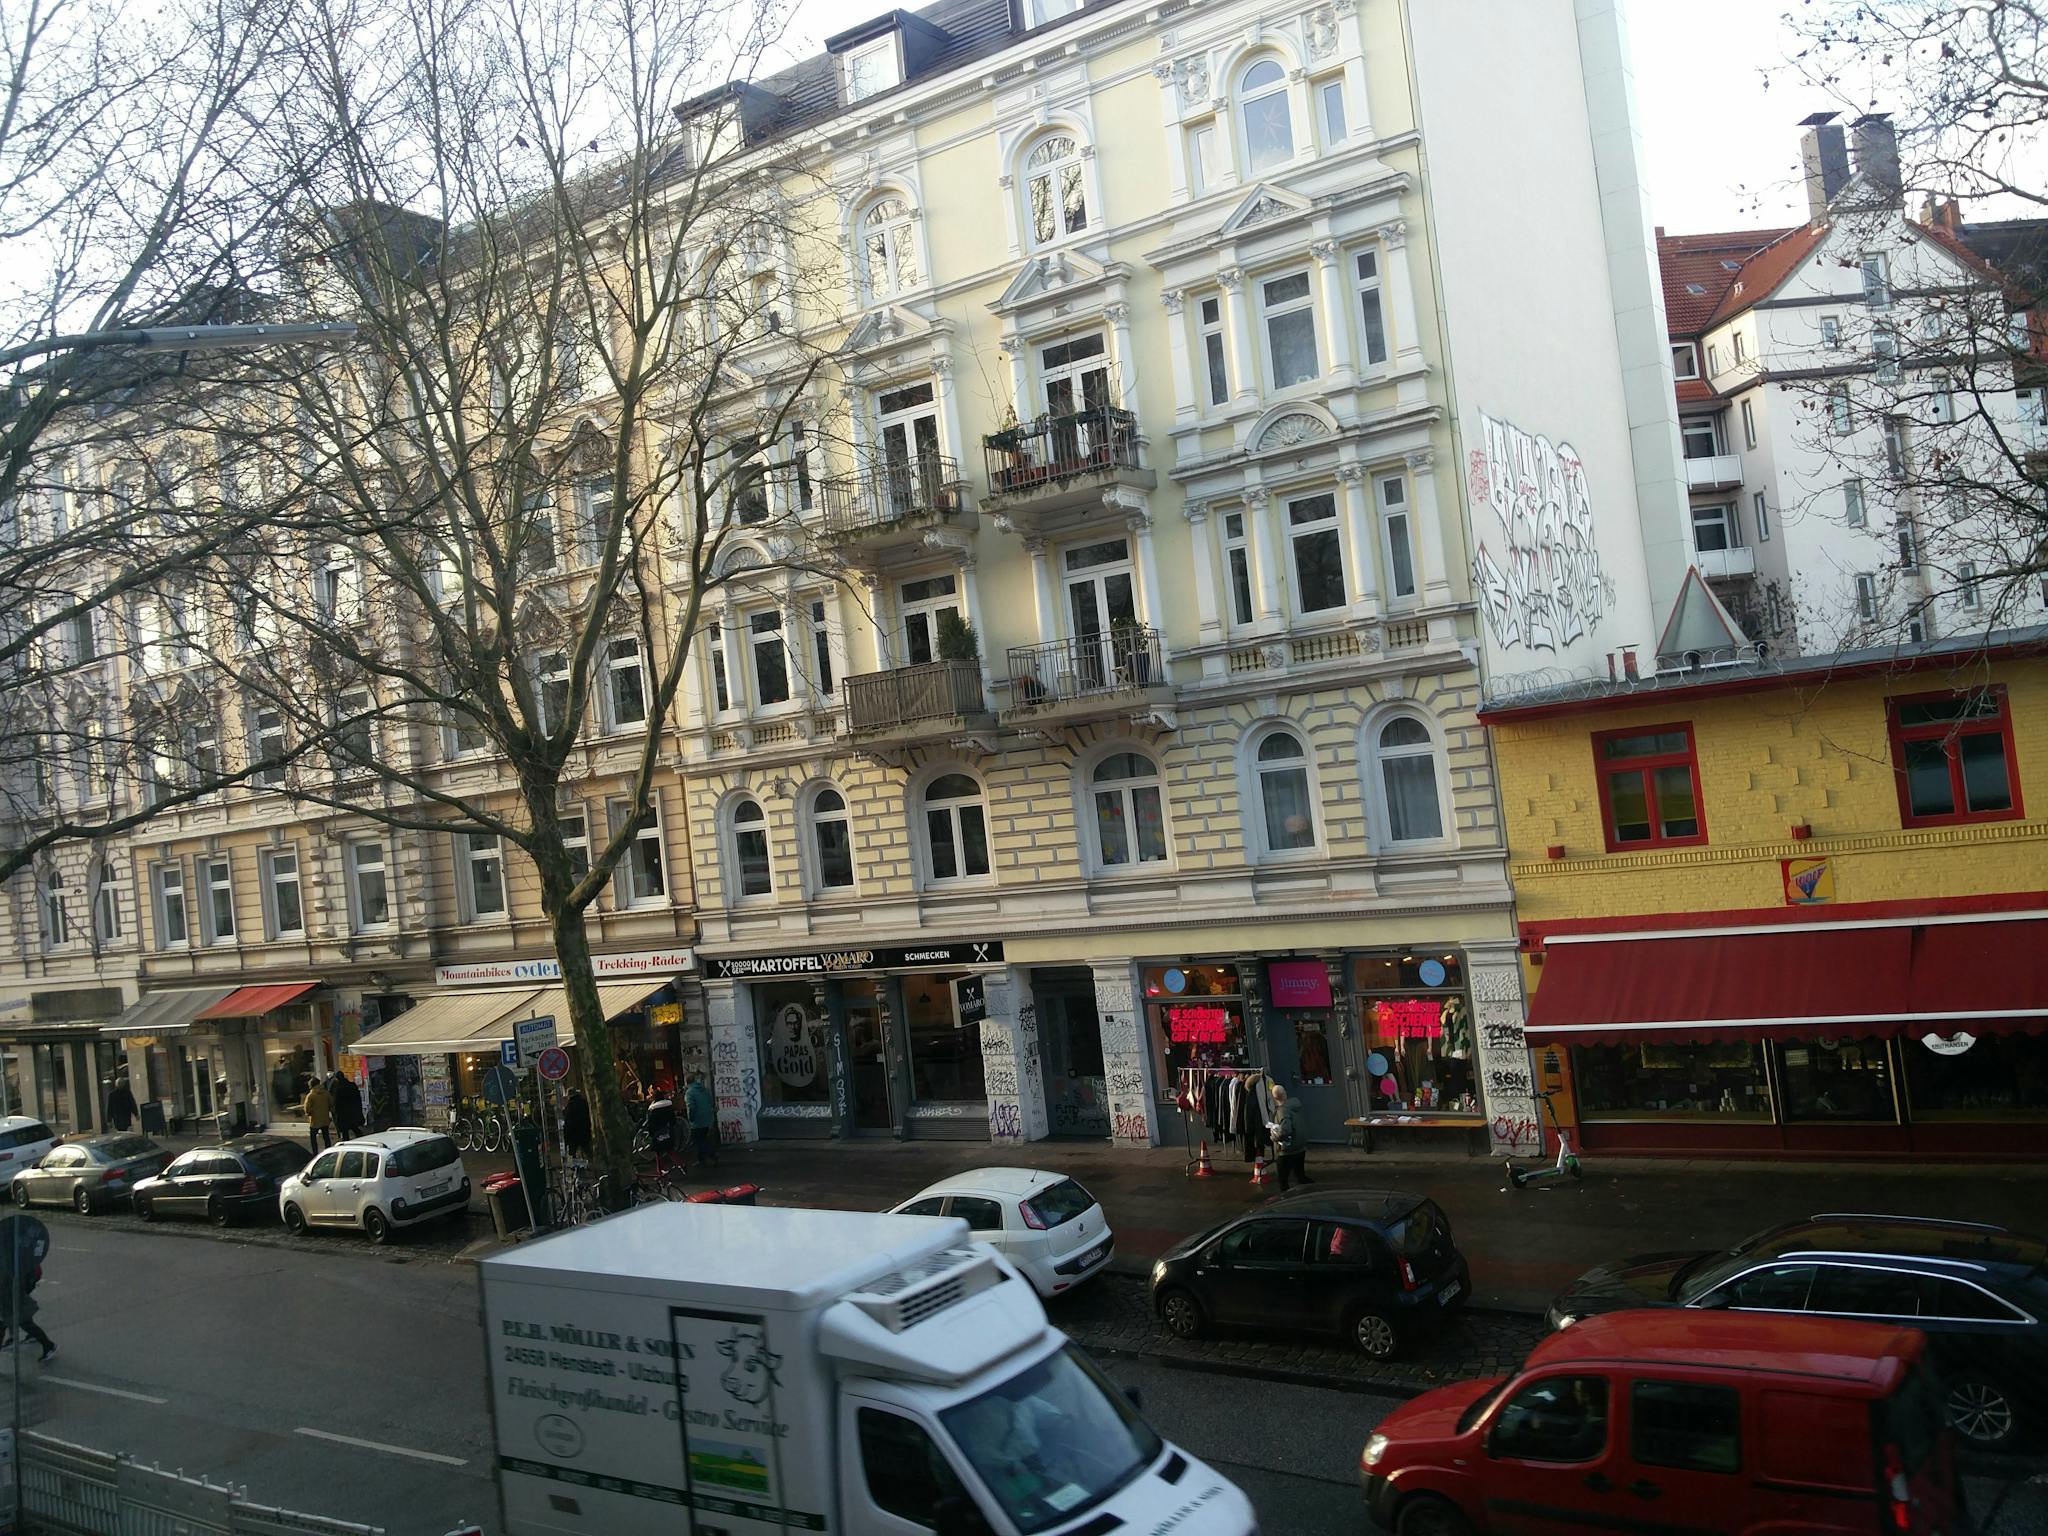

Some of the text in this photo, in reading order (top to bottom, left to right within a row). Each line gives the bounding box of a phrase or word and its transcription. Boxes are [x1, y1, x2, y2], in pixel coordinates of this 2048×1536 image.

[820, 950, 874, 966] YOMARO
[904, 950, 951, 962] SCHMECKEN
[440, 967, 512, 981] Mountainbikes
[514, 962, 551, 979] cycle
[597, 955, 688, 971] Trekking-Räder
[751, 956, 823, 973] KARTOFFEL
[521, 1020, 552, 1033] AUTOMAT
[784, 1045, 809, 1057] PAPAS
[777, 1056, 814, 1077] Gold
[549, 1323, 622, 1350] MÖLLER
[624, 1335, 640, 1353] &
